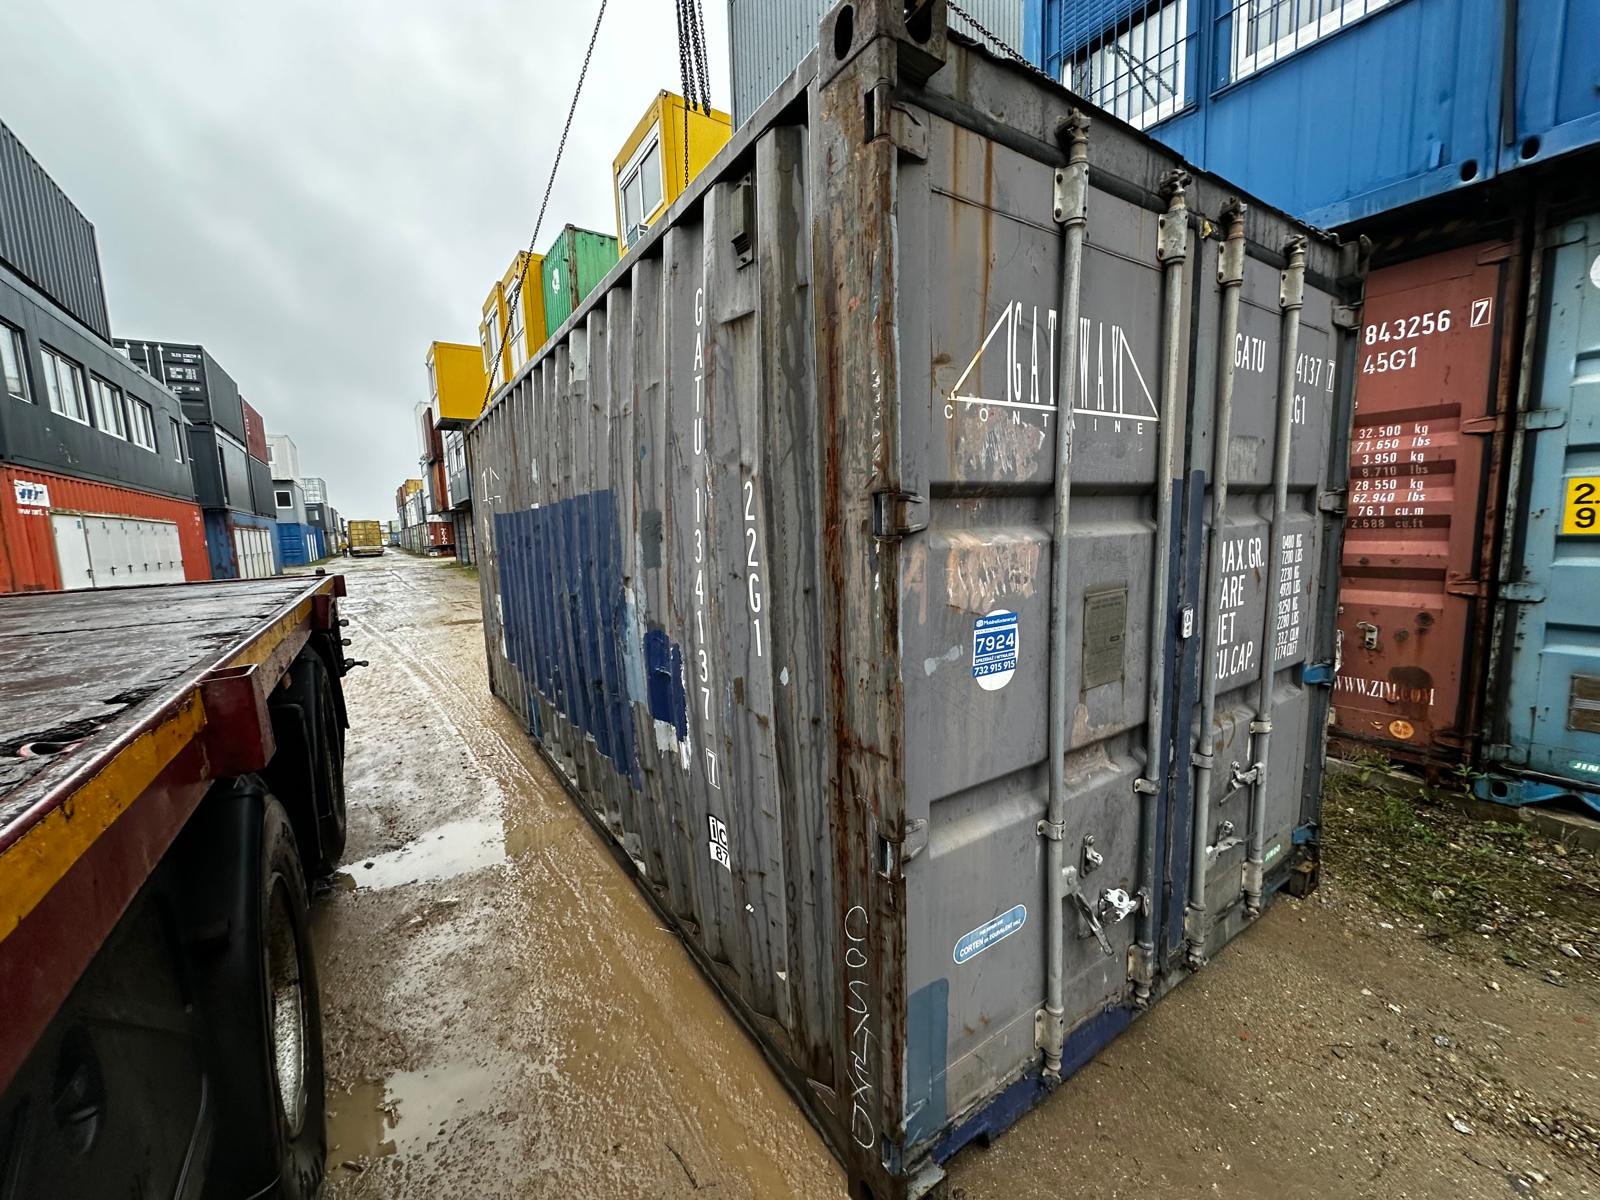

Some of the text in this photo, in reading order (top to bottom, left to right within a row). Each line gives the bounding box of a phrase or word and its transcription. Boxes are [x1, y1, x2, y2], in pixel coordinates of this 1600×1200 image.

[1365, 300, 1489, 346] 843256 7
[1012, 301, 1120, 413] GATWAY
[1234, 332, 1266, 373] GATU
[1296, 352, 1322, 387] 4137
[1363, 346, 1417, 375] 45G1
[693, 288, 703, 456] GATU
[1290, 394, 1306, 425] G1
[1359, 423, 1429, 439] 32.500 kg
[1356, 436, 1431, 452] 71.650 lbs
[1362, 451, 1424, 465] 3.950 kg
[1362, 465, 1429, 477] 8.710 lbs
[1355, 478, 1424, 491] 28.550 kg
[1352, 491, 1427, 503] 62.940 lbs
[1358, 505, 1424, 516] 76.1 cu.m
[1351, 519, 1385, 528] 2.688
[743, 480, 762, 657] 22G1
[1220, 575, 1246, 609] ARE
[694, 487, 711, 720] 134137
[977, 633, 1014, 653] 7924
[974, 660, 1015, 676] 732 915 915
[1574, 762, 1600, 772] JIN
[960, 937, 984, 957] CORTEN
